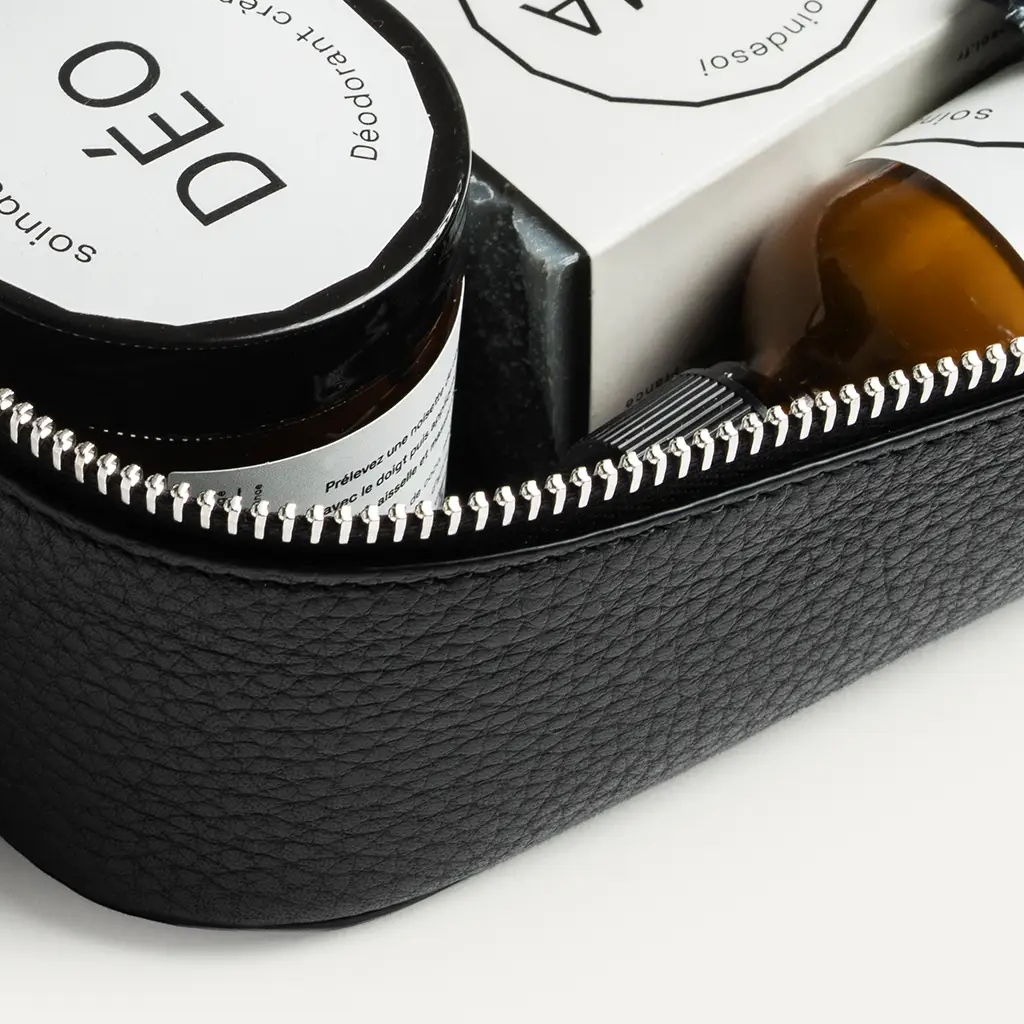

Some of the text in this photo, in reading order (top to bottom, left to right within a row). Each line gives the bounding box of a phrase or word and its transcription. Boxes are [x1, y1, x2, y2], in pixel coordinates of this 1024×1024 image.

[58, 40, 288, 227] DÉO
[295, 26, 380, 162] Déodorant
[323, 493, 358, 516] avec
[361, 485, 373, 497] le
[376, 454, 408, 487] doigt
[409, 431, 429, 461] puis
[325, 454, 384, 493] Prélevez
[386, 434, 409, 458] une
[377, 464, 418, 507] aisselle
